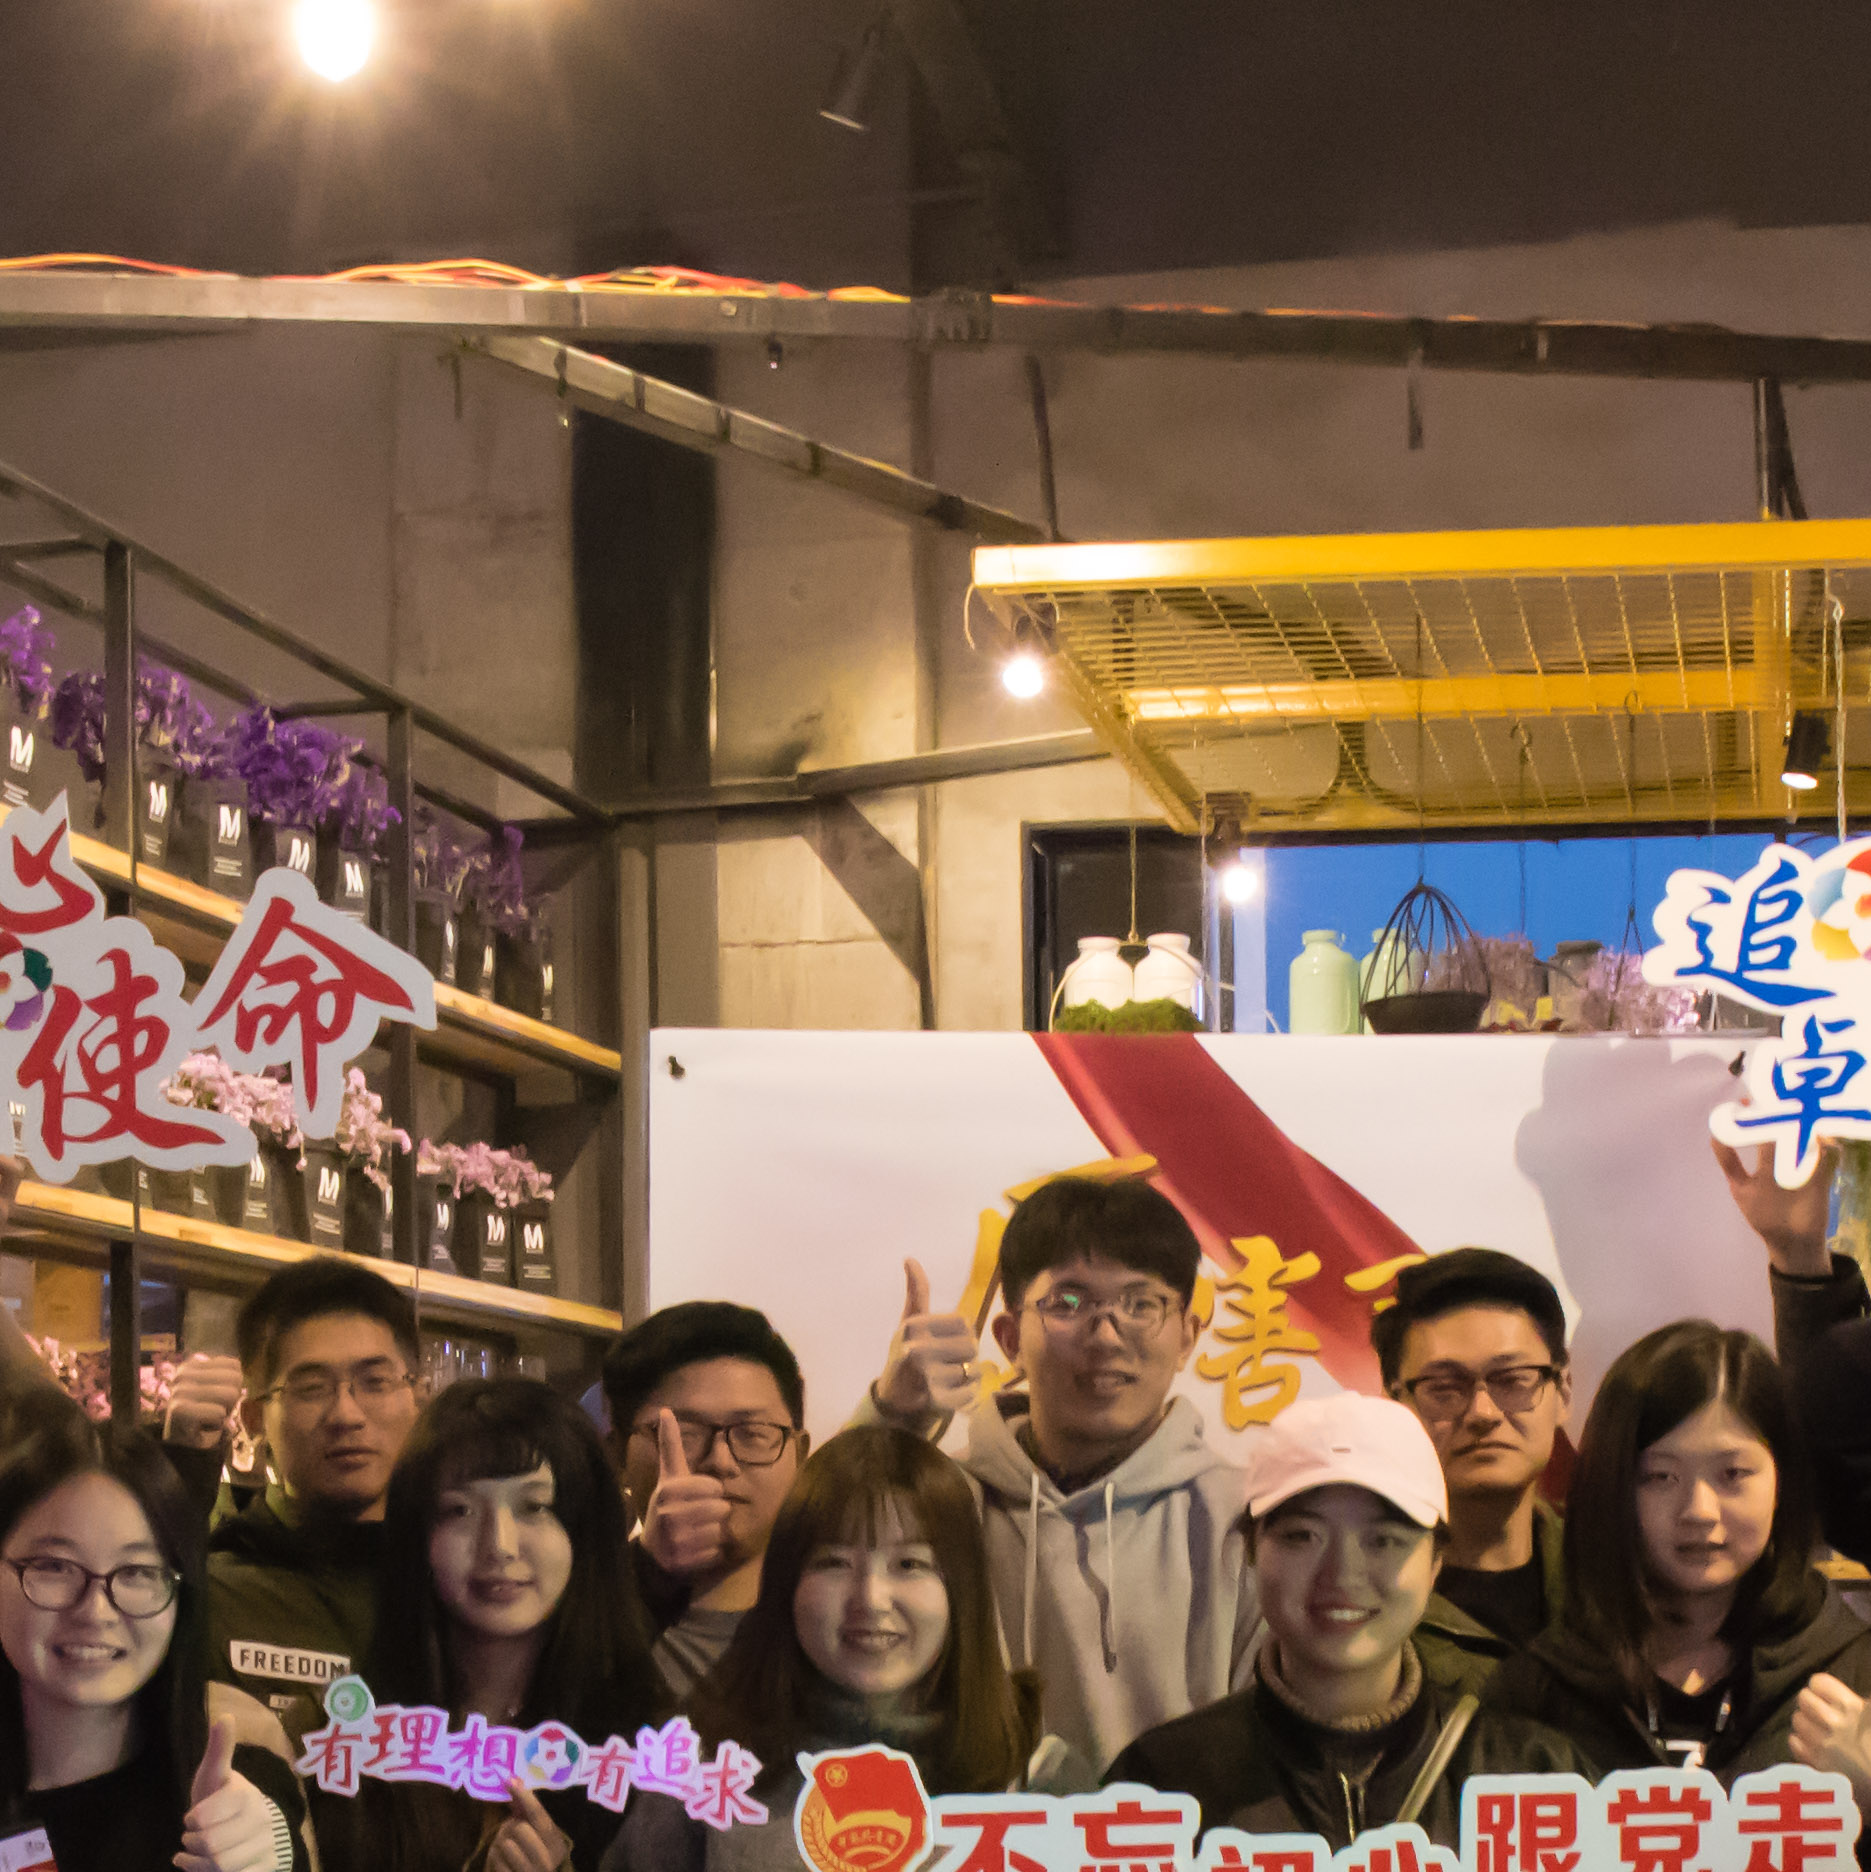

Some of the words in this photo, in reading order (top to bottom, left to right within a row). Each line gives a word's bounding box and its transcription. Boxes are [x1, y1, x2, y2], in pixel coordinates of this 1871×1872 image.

[11, 726, 34, 768] M
[219, 804, 241, 841] M
[239, 1648, 345, 1681] FREEDOM
